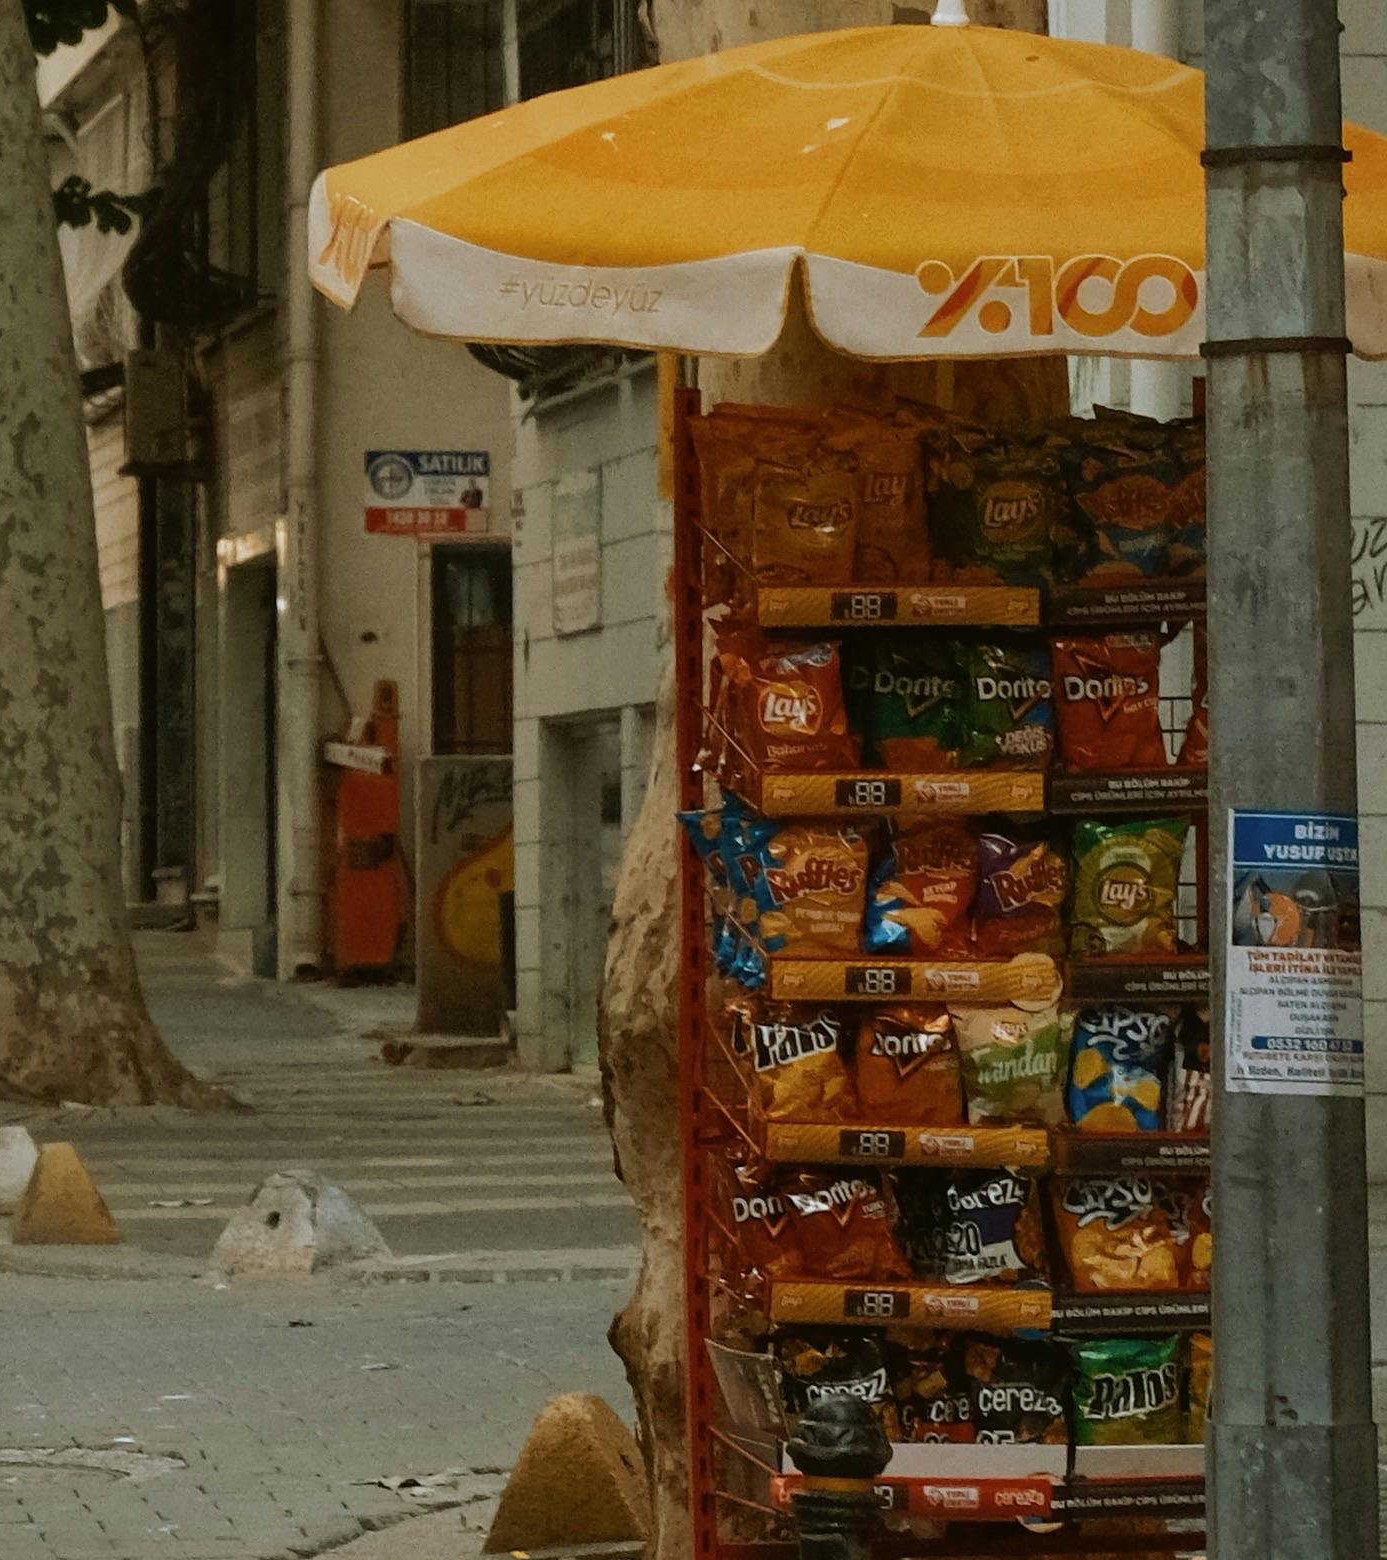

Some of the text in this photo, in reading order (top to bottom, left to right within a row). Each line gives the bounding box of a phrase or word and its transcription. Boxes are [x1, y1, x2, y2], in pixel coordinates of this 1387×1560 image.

[915, 253, 1197, 337] %100
[419, 455, 485, 472] SATILIK
[976, 677, 1051, 701] Dorito
[763, 691, 818, 732] Lay's
[1264, 844, 1325, 861] YUSUF
[767, 857, 864, 904] Ruffles
[1101, 879, 1148, 910] Lay's
